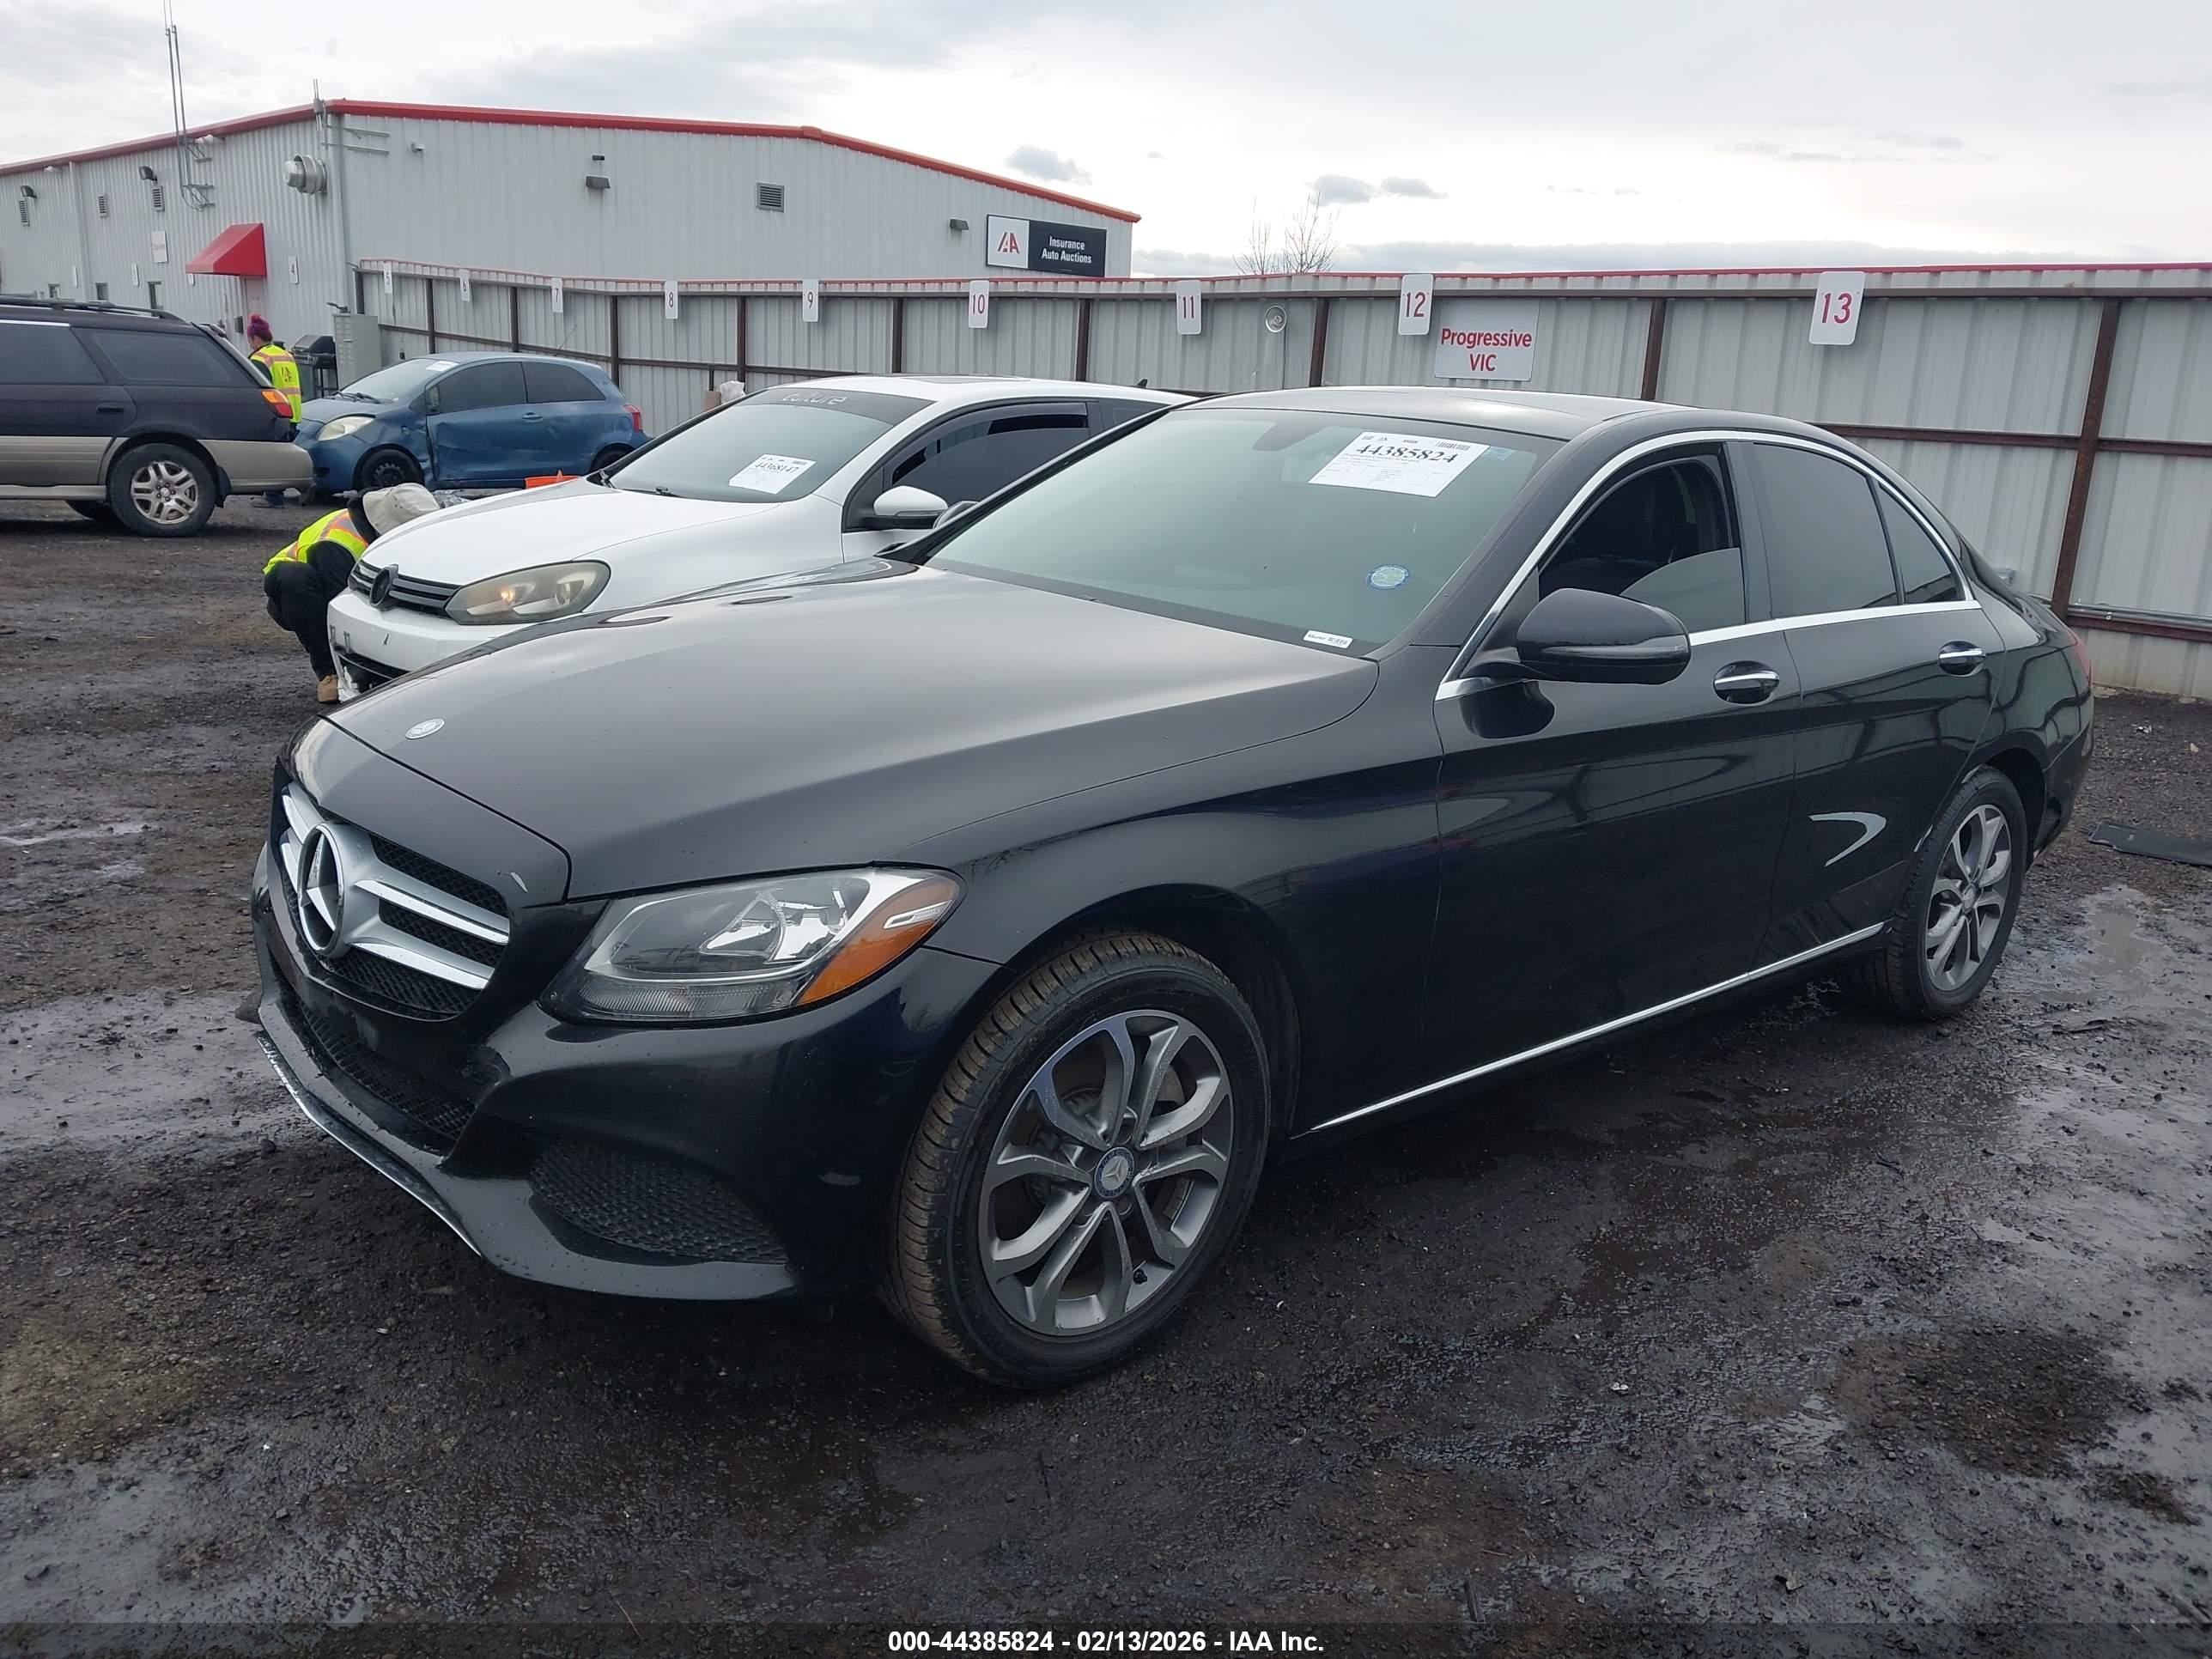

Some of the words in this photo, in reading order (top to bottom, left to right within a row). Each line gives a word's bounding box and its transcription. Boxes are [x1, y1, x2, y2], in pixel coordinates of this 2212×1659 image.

[1048, 234, 1085, 251] Insurance
[1041, 247, 1060, 261] Auto
[1060, 250, 1092, 264] Auctions
[462, 277, 467, 292] 6
[552, 287, 559, 303] 7
[668, 291, 674, 308] 8
[807, 291, 814, 309] 9
[971, 293, 986, 315] 10
[1405, 291, 1426, 318] 12
[1182, 295, 1195, 319] 11
[1821, 292, 1853, 325] 13
[1440, 327, 1533, 349] Progressive
[1468, 353, 1498, 372] VIC
[1356, 443, 1459, 464] 44385824
